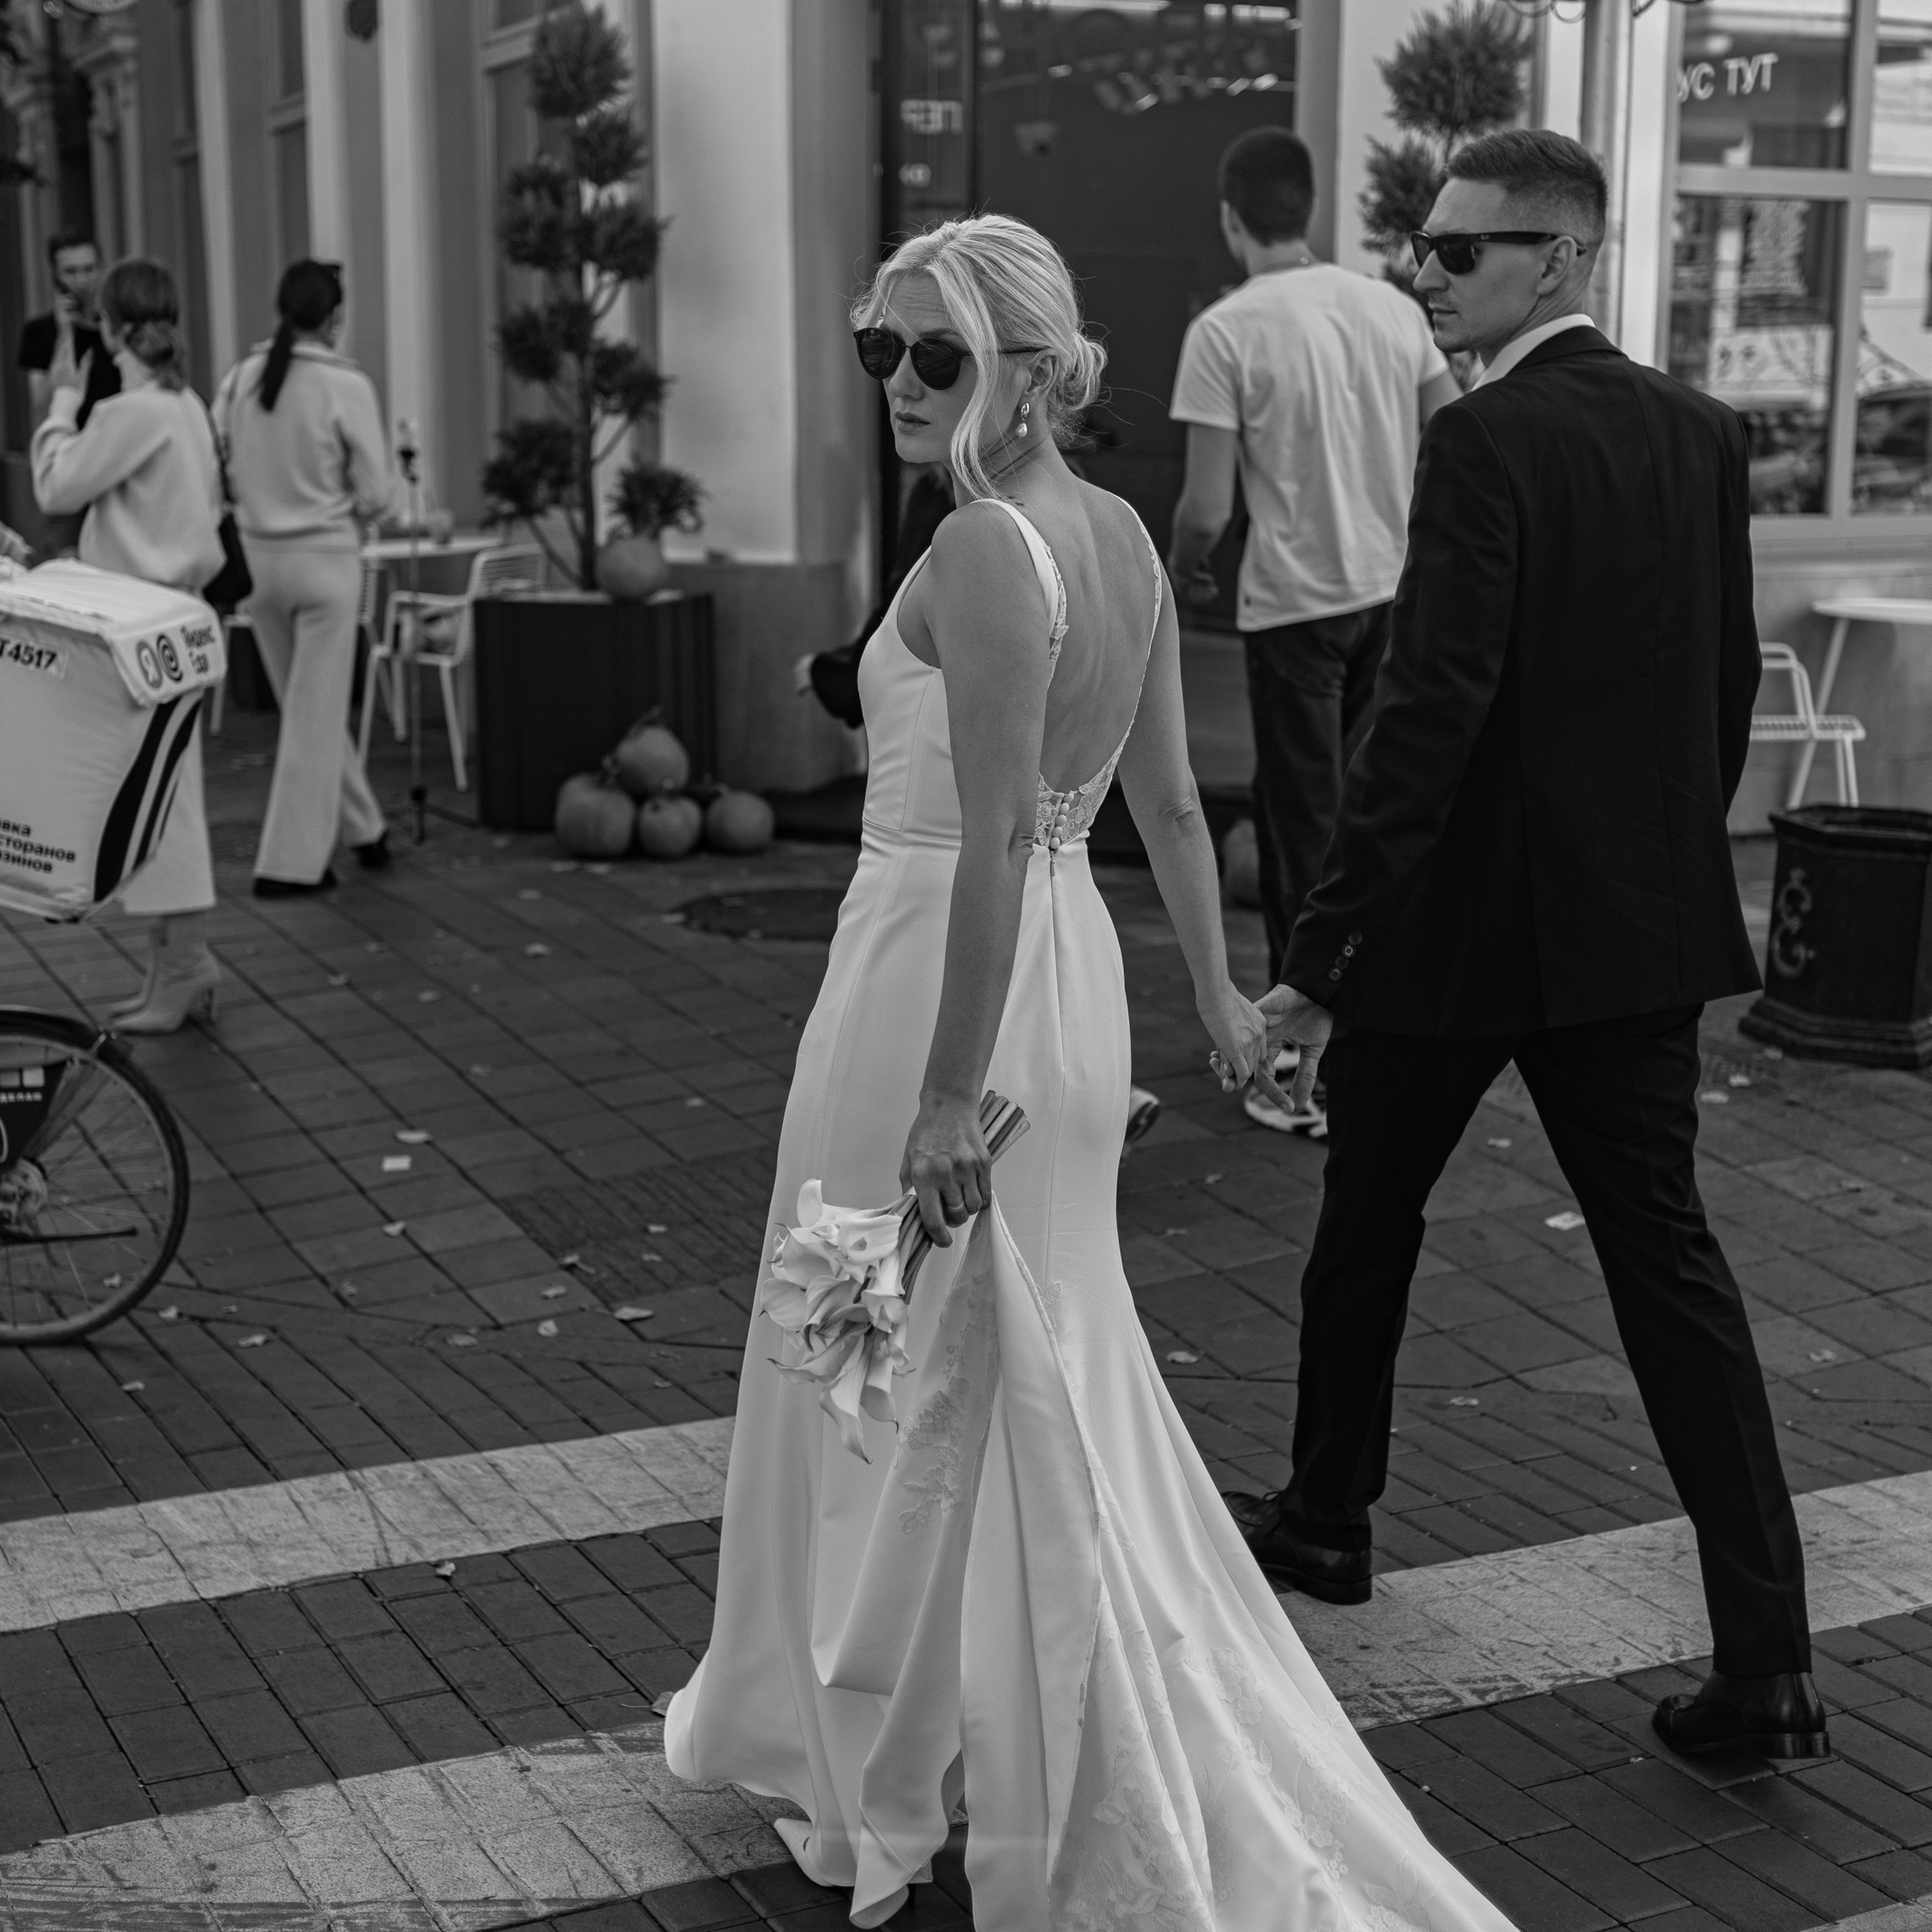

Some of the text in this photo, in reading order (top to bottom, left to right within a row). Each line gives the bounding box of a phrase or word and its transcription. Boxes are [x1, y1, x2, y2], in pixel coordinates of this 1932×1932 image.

[1722, 51, 1779, 97] ТУТ
[0, 820, 31, 838] вка
[0, 849, 53, 874] зинов
